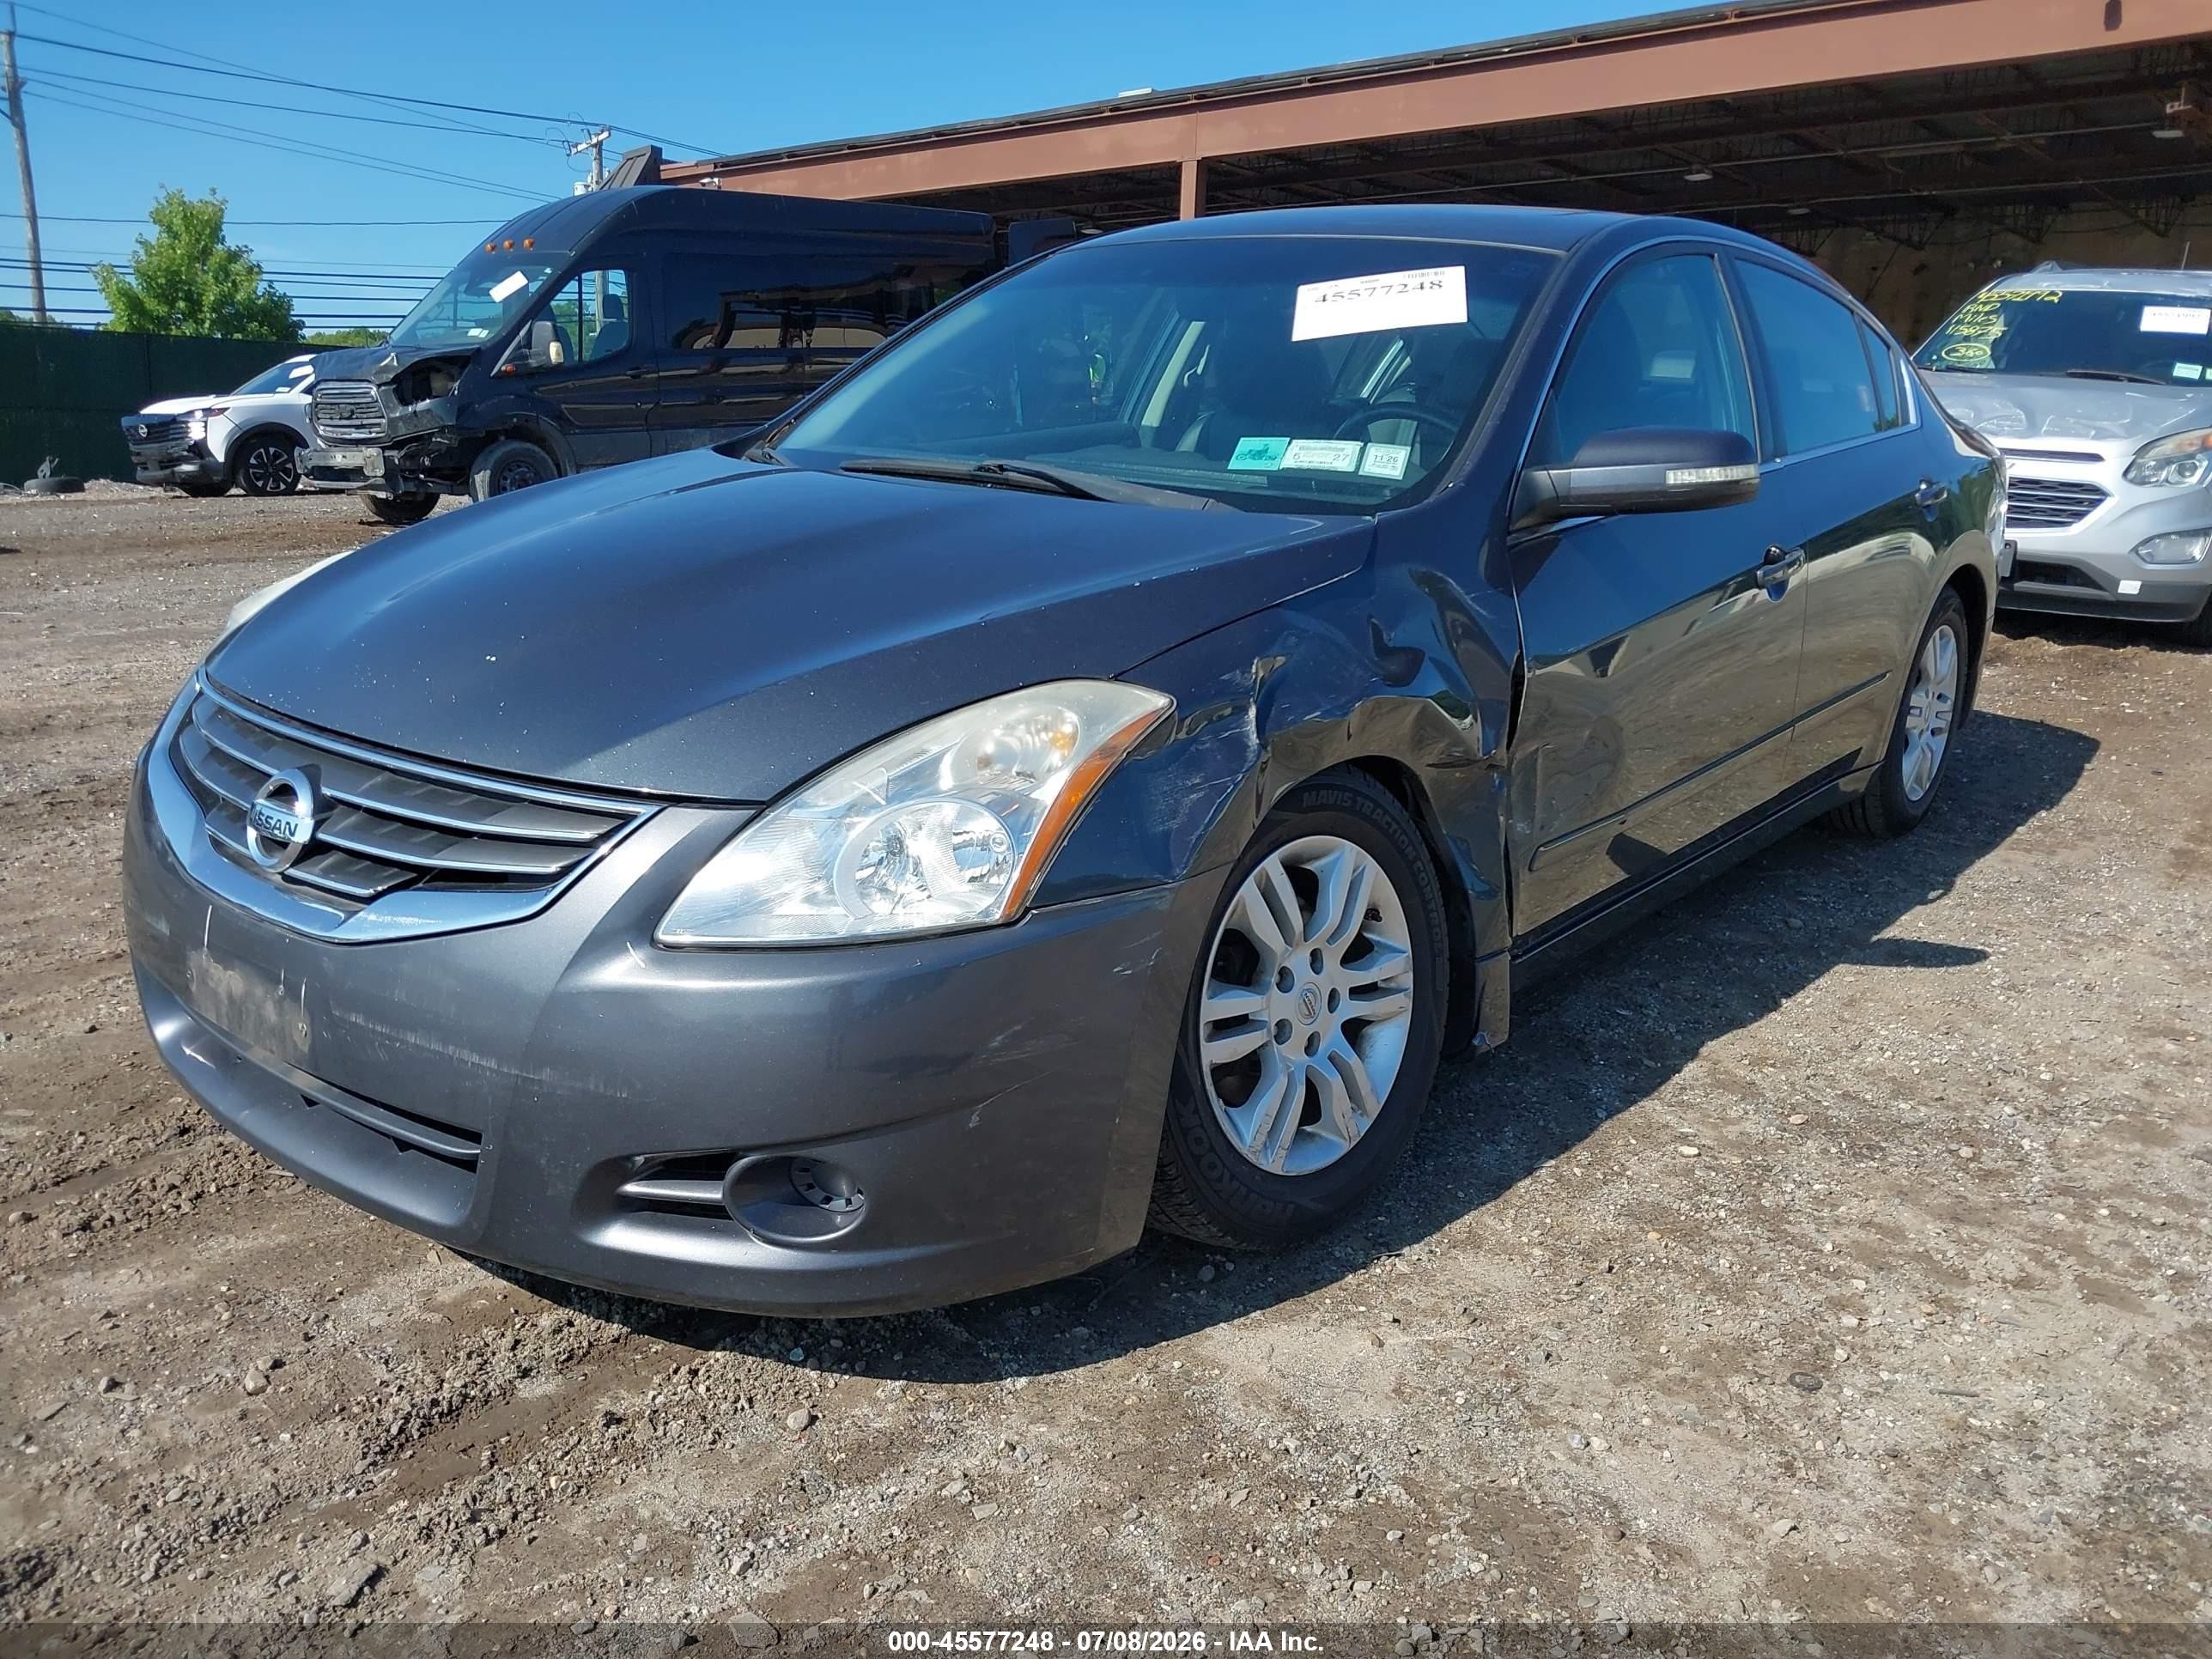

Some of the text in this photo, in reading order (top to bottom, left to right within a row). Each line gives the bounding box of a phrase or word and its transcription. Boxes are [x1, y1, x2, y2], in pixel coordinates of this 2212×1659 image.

[1314, 279, 1443, 303] 45577248
[1302, 791, 1353, 808] MAVIS
[1356, 795, 1416, 865] TRACTION
